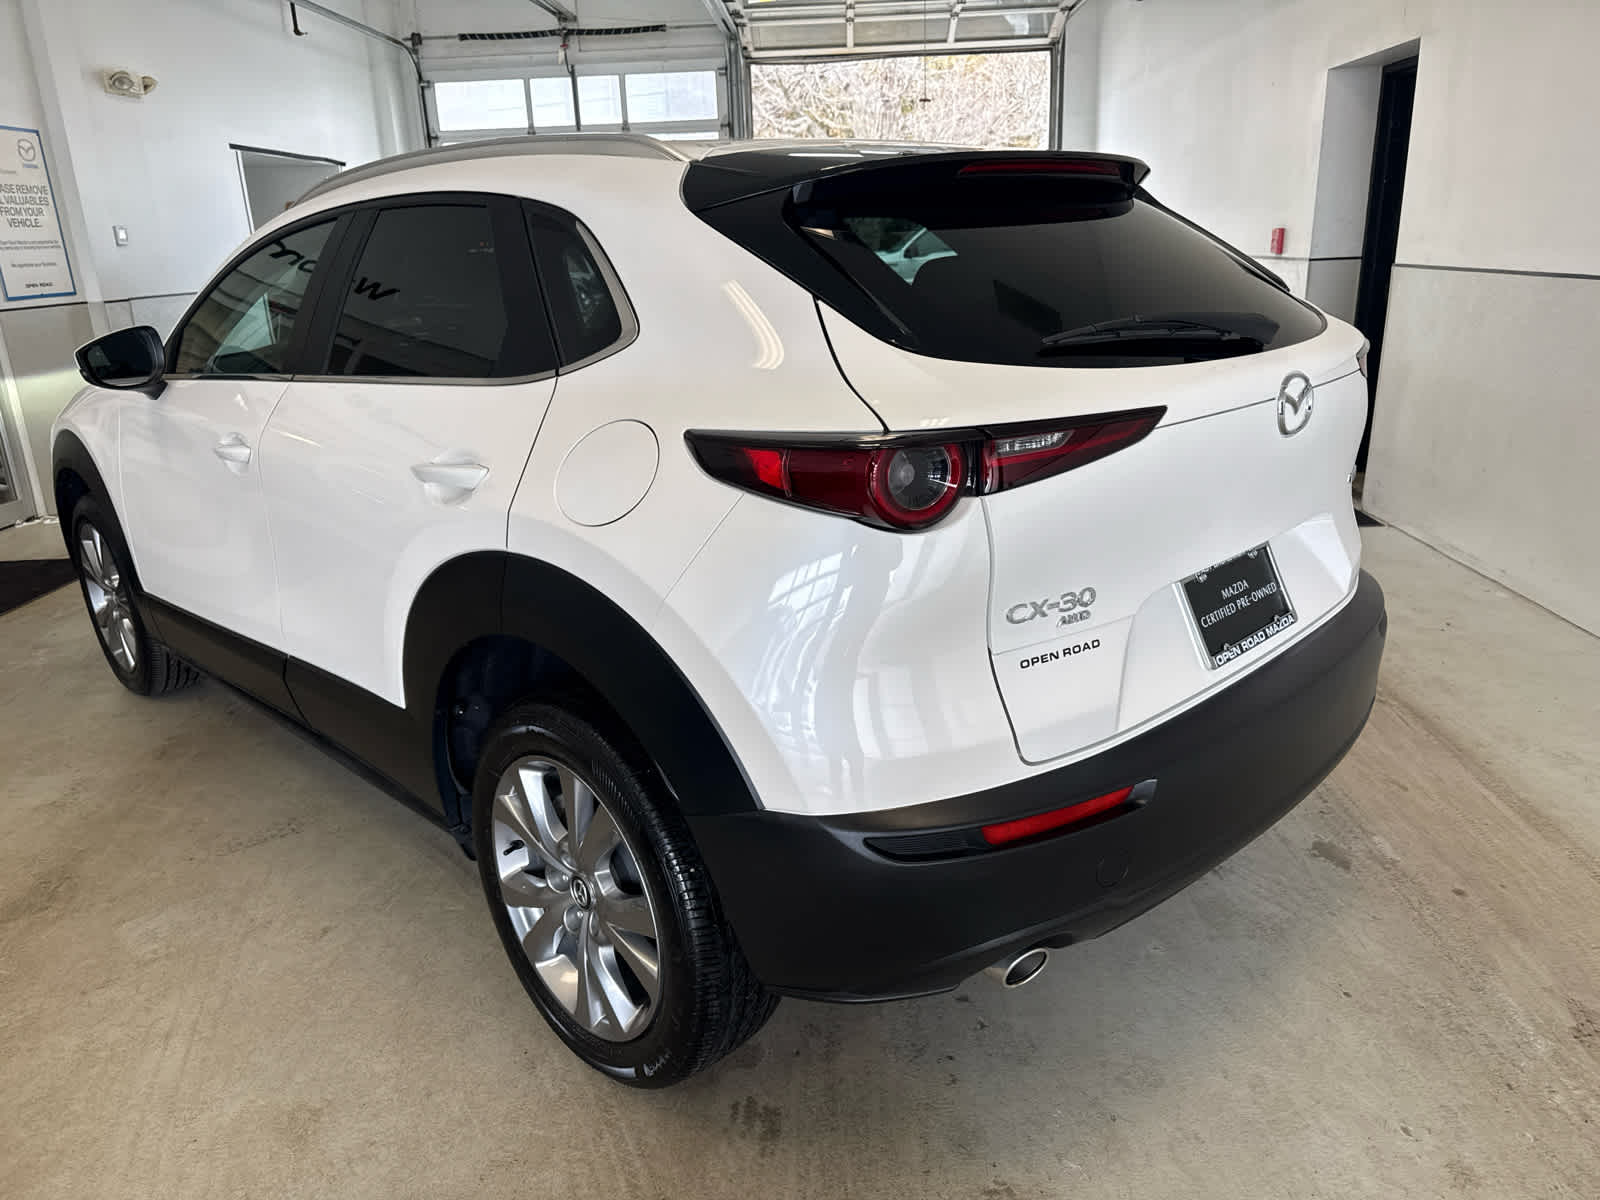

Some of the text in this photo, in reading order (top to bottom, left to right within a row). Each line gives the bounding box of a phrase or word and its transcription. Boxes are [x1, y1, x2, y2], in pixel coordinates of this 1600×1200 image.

[4, 195, 49, 206] VALUABLES
[16, 184, 48, 195] REMOVE
[0, 206, 45, 217] FROM YOUR
[1221, 579, 1249, 600] MAZDA
[1006, 587, 1096, 624] CX-30
[1200, 582, 1277, 628] CERTIFIED PRE-OWNED
[1216, 614, 1295, 666] OPEN ROAD MAZDA
[1020, 639, 1100, 669] OPEN ROAD
